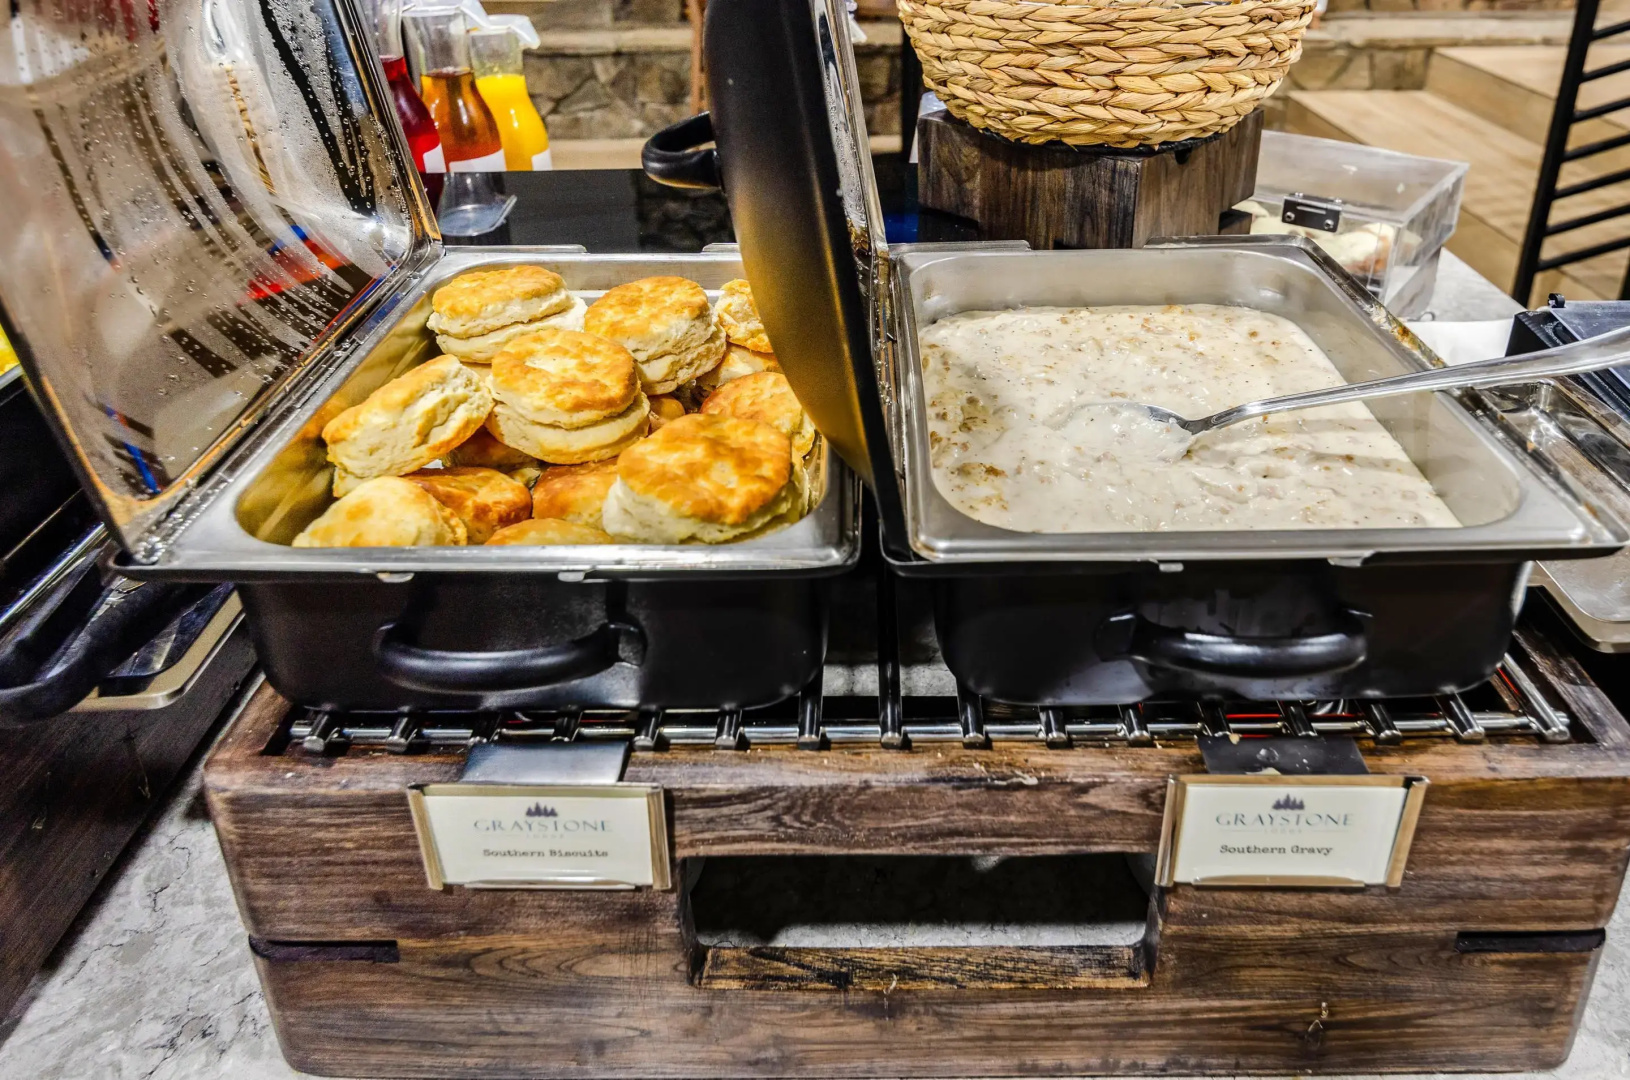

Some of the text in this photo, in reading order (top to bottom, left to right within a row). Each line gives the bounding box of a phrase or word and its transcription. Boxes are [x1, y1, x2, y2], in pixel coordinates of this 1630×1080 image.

[474, 819, 612, 833] GRAYSTONE
[1216, 813, 1353, 827] GRAYSTONE
[483, 848, 608, 858] Southern Biscuits
[1219, 844, 1333, 856] Southern Gravy
